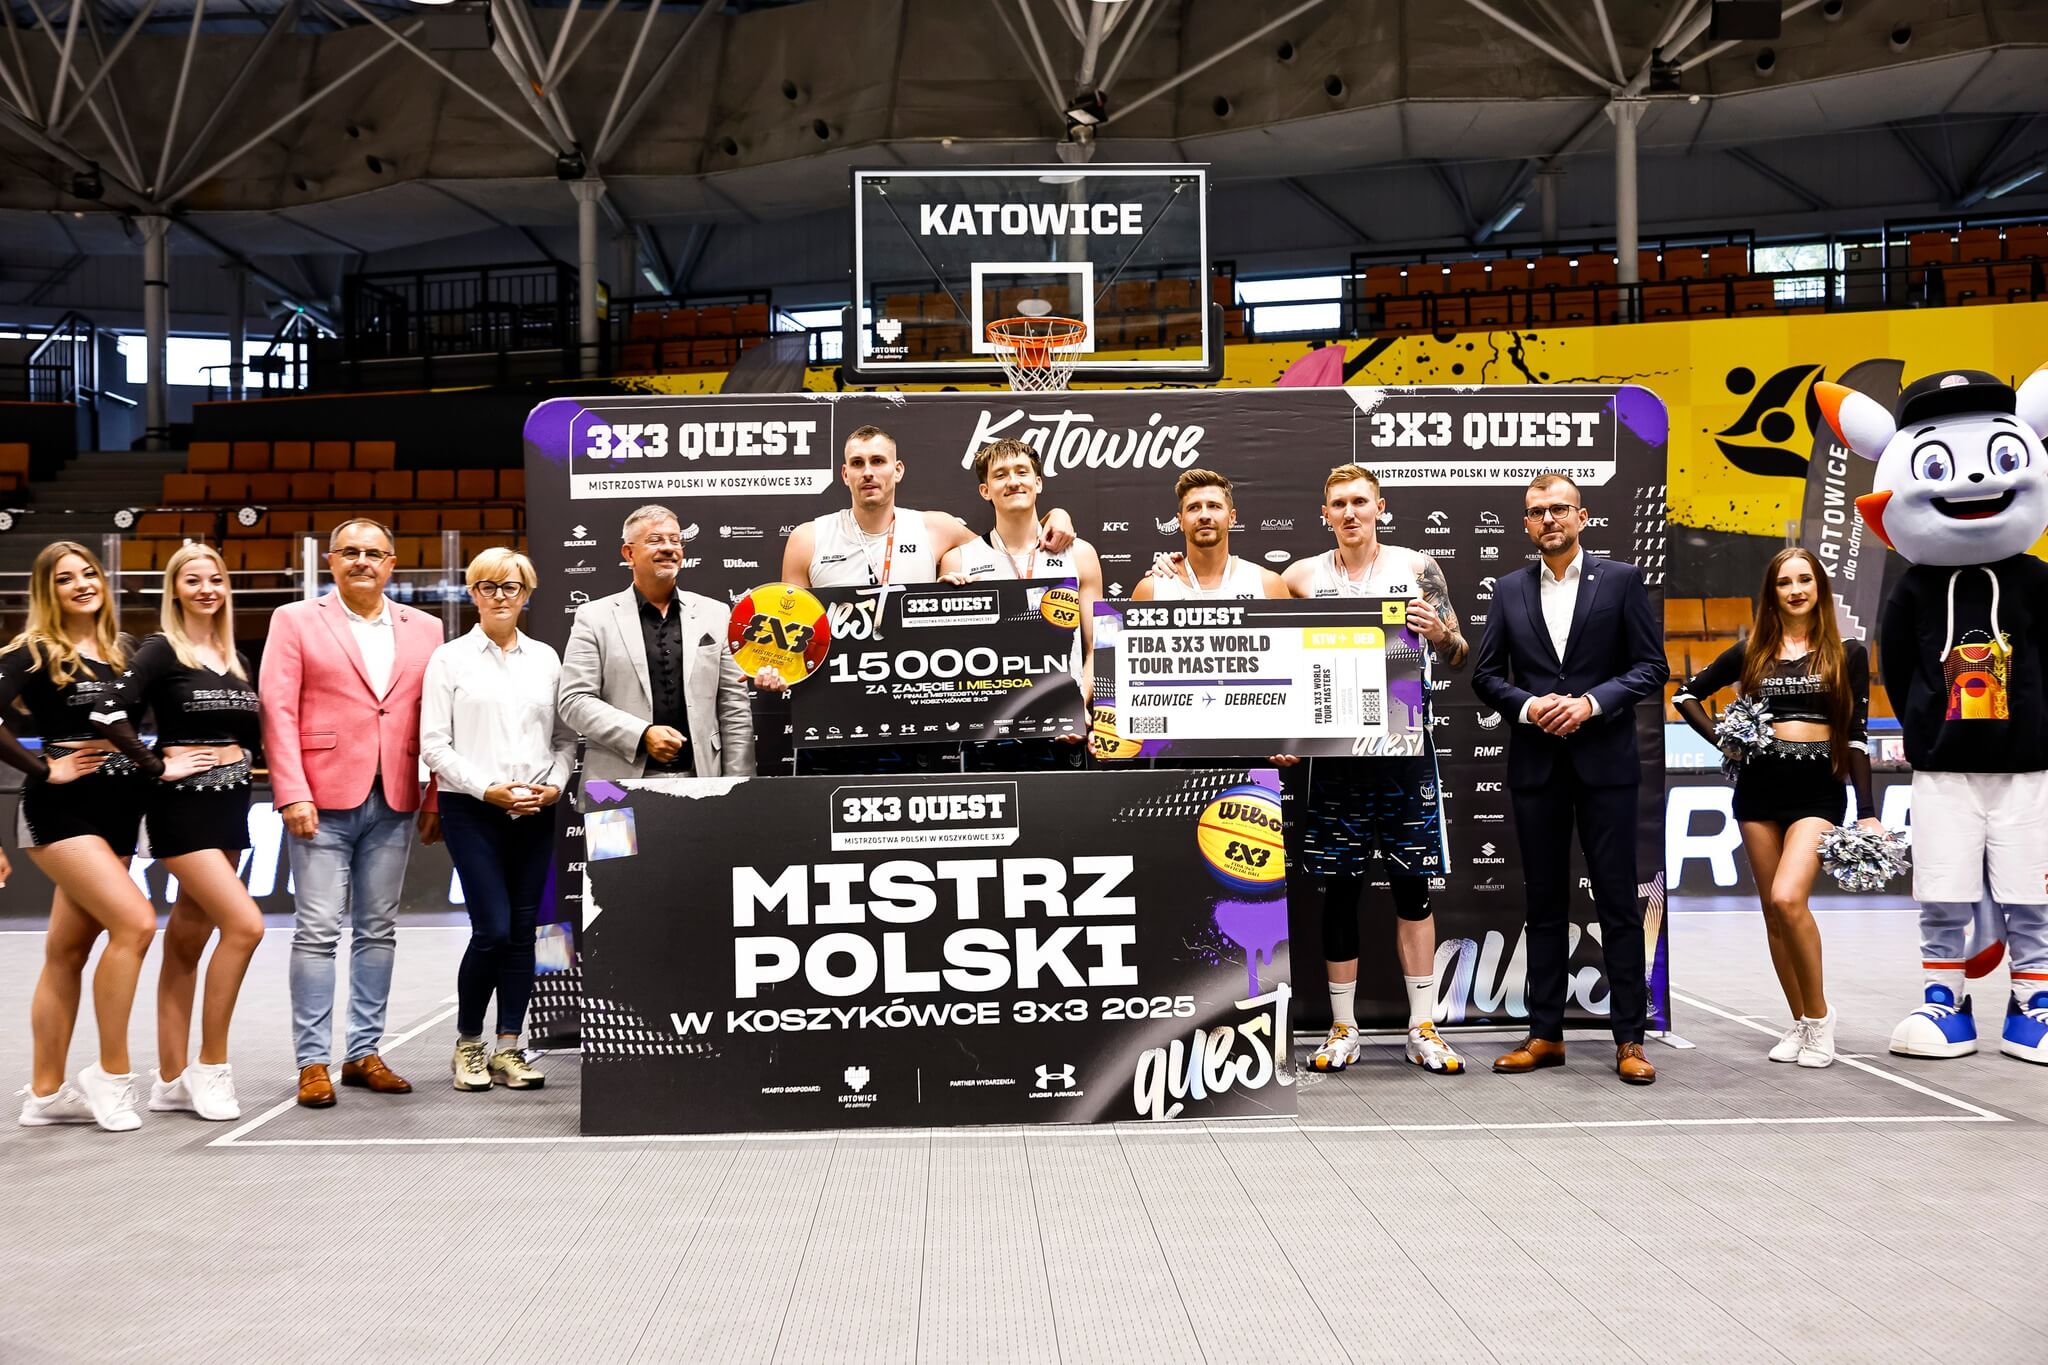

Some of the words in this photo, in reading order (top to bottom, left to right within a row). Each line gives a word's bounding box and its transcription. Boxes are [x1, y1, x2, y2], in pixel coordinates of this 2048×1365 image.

[920, 203, 1144, 236] KATOWICE
[1370, 412, 1452, 447] 3X3
[1463, 412, 1600, 450] QUEST
[586, 423, 669, 459] 3X3
[679, 420, 817, 461] QUEST
[1372, 468, 1447, 479] MISTRZOSTWA
[1450, 468, 1487, 478] POLSKI
[1490, 468, 1500, 478] W
[1577, 468, 1596, 478] 3X3
[588, 479, 664, 491] MISTRZOSTWA
[667, 478, 704, 489] POLSKI
[706, 478, 718, 488] W
[720, 475, 791, 488] KOSZYKÓWCE
[793, 476, 813, 487] 3X3
[1818, 443, 1849, 578] KATOWICE
[1102, 521, 1129, 532] KFC
[563, 539, 597, 547] SUZUKI
[681, 558, 702, 569] MF
[722, 558, 758, 568] Wilson
[907, 599, 939, 613] 3X3
[941, 596, 993, 613] QUEST
[1126, 608, 1169, 627] 3X3
[1173, 607, 1245, 627] QUEST
[1127, 636, 1166, 653] FIBA
[1171, 635, 1205, 653] 3X3
[1209, 635, 1271, 652] WORLD
[1002, 654, 1068, 675] PLN
[1128, 657, 1173, 674] TOUR
[1178, 656, 1260, 674] MASTERS
[1313, 664, 1321, 690] WORLD
[1431, 680, 1452, 691] MF
[865, 685, 888, 694] ZA
[891, 681, 955, 694] ZAJĘCIE
[958, 681, 963, 690] I
[966, 678, 1033, 690] MIEJSCA
[1323, 669, 1331, 703] MASTERS
[1131, 693, 1194, 707] KATOWICE
[1224, 692, 1287, 706] DEBRECEN
[1314, 691, 1322, 706] 3X3
[1315, 707, 1323, 724] FIBA
[1324, 704, 1332, 724] TOUR
[1432, 716, 1450, 726] FC
[1474, 746, 1504, 757] RMF
[1475, 782, 1502, 792] KFC
[842, 796, 901, 823] 3X3
[908, 793, 1006, 824] QUEST
[844, 836, 899, 845] MISTRZOSTWA
[900, 835, 928, 843] POLSKI
[938, 833, 990, 842] KOSZYKÓWCE
[991, 833, 1005, 841] 3X3
[732, 855, 1137, 928] MISTRZ
[734, 924, 1139, 999] POLSKI
[670, 1011, 714, 1035] W
[727, 997, 1000, 1034] KOSZYKÓWCE
[1101, 996, 1197, 1021] 2025
[838, 1094, 877, 1103] KATOWICE
